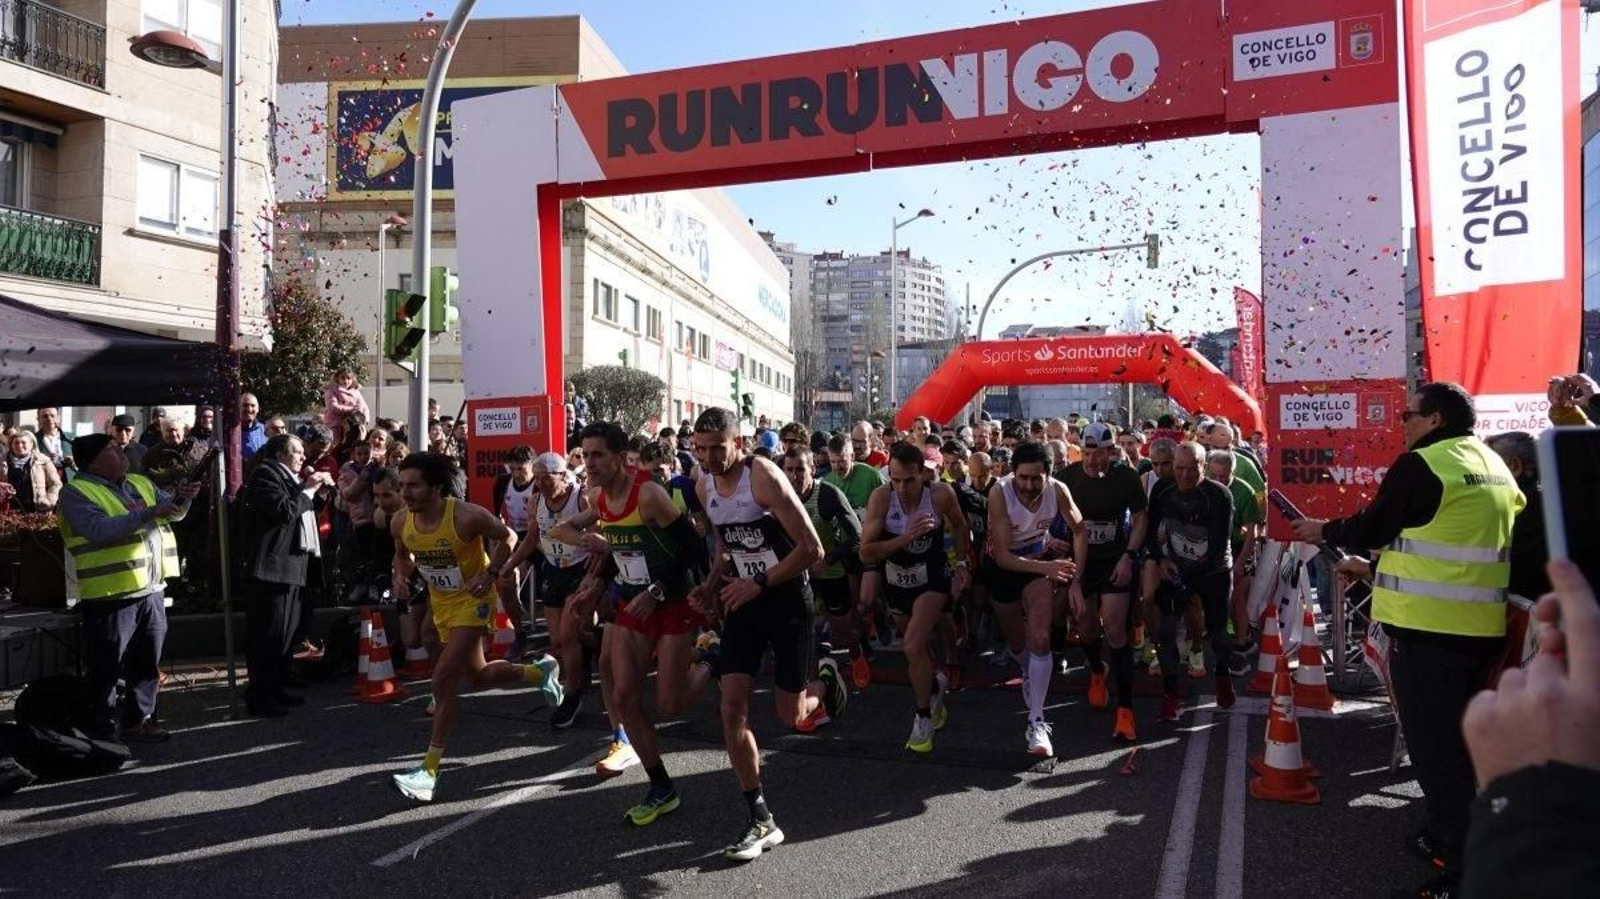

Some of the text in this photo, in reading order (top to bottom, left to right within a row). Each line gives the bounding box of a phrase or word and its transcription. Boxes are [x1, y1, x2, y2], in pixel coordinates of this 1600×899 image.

[1240, 32, 1327, 56] CONCELLO
[1250, 48, 1318, 70] DE VIGO
[1493, 63, 1529, 237] DE VIGO
[1455, 49, 1496, 271] CONCELLO
[981, 342, 1146, 367] Sports Santander
[1285, 400, 1351, 412] CONCELLO
[478, 412, 517, 423] CONCELLO
[1293, 411, 1344, 422] DE VIGO
[483, 421, 513, 430] DE VIGO
[1281, 449, 1334, 466] RUN
[551, 543, 564, 555] 15
